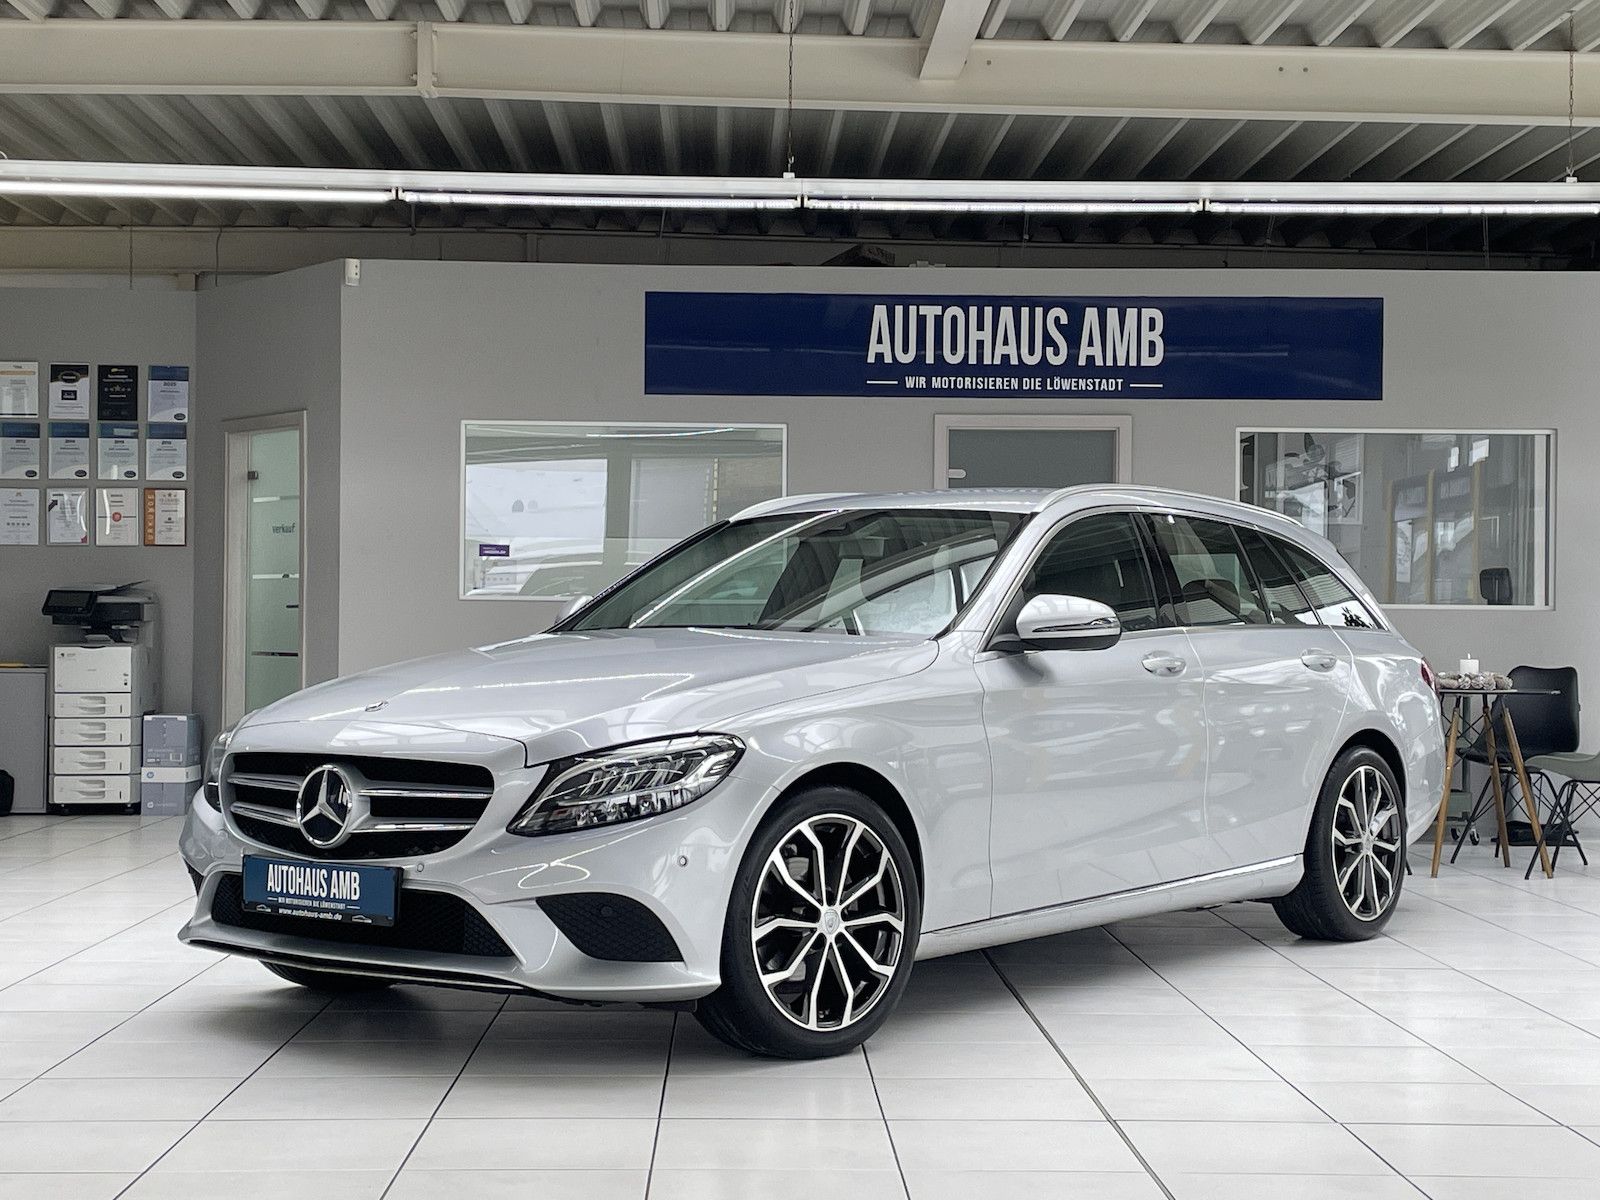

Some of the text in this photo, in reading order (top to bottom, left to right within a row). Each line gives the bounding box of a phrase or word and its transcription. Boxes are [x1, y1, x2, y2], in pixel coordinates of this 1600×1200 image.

[866, 304, 1165, 368] AUTOHAUS AMB
[904, 375, 1124, 392] WIR MOTORISIEREN DIE LÖWENSTADT
[267, 864, 360, 900] AUTOHAUS AMB
[278, 908, 342, 920] www.autohaus-amb.de
